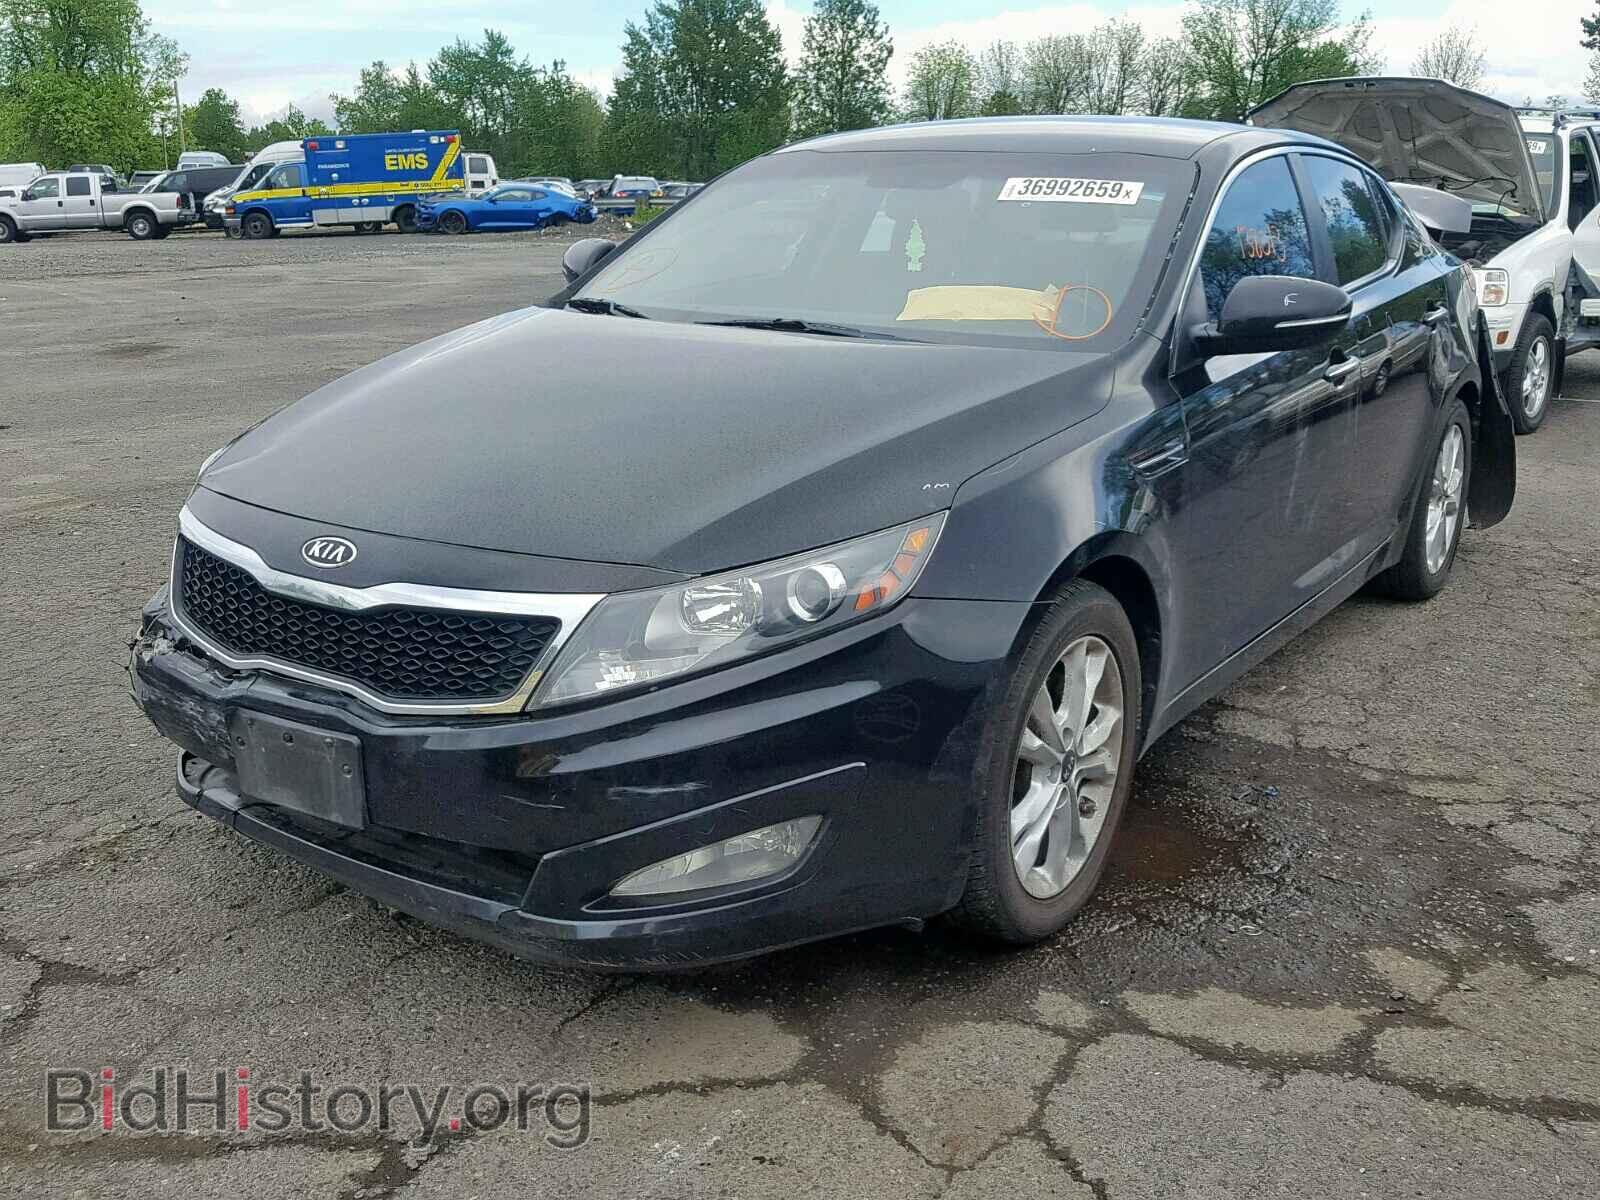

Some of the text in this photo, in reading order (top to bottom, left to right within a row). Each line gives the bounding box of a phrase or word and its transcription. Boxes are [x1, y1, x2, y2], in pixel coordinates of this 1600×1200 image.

[384, 154, 429, 170] EMS
[1017, 178, 1124, 198] 36992659
[307, 541, 346, 562] KIA
